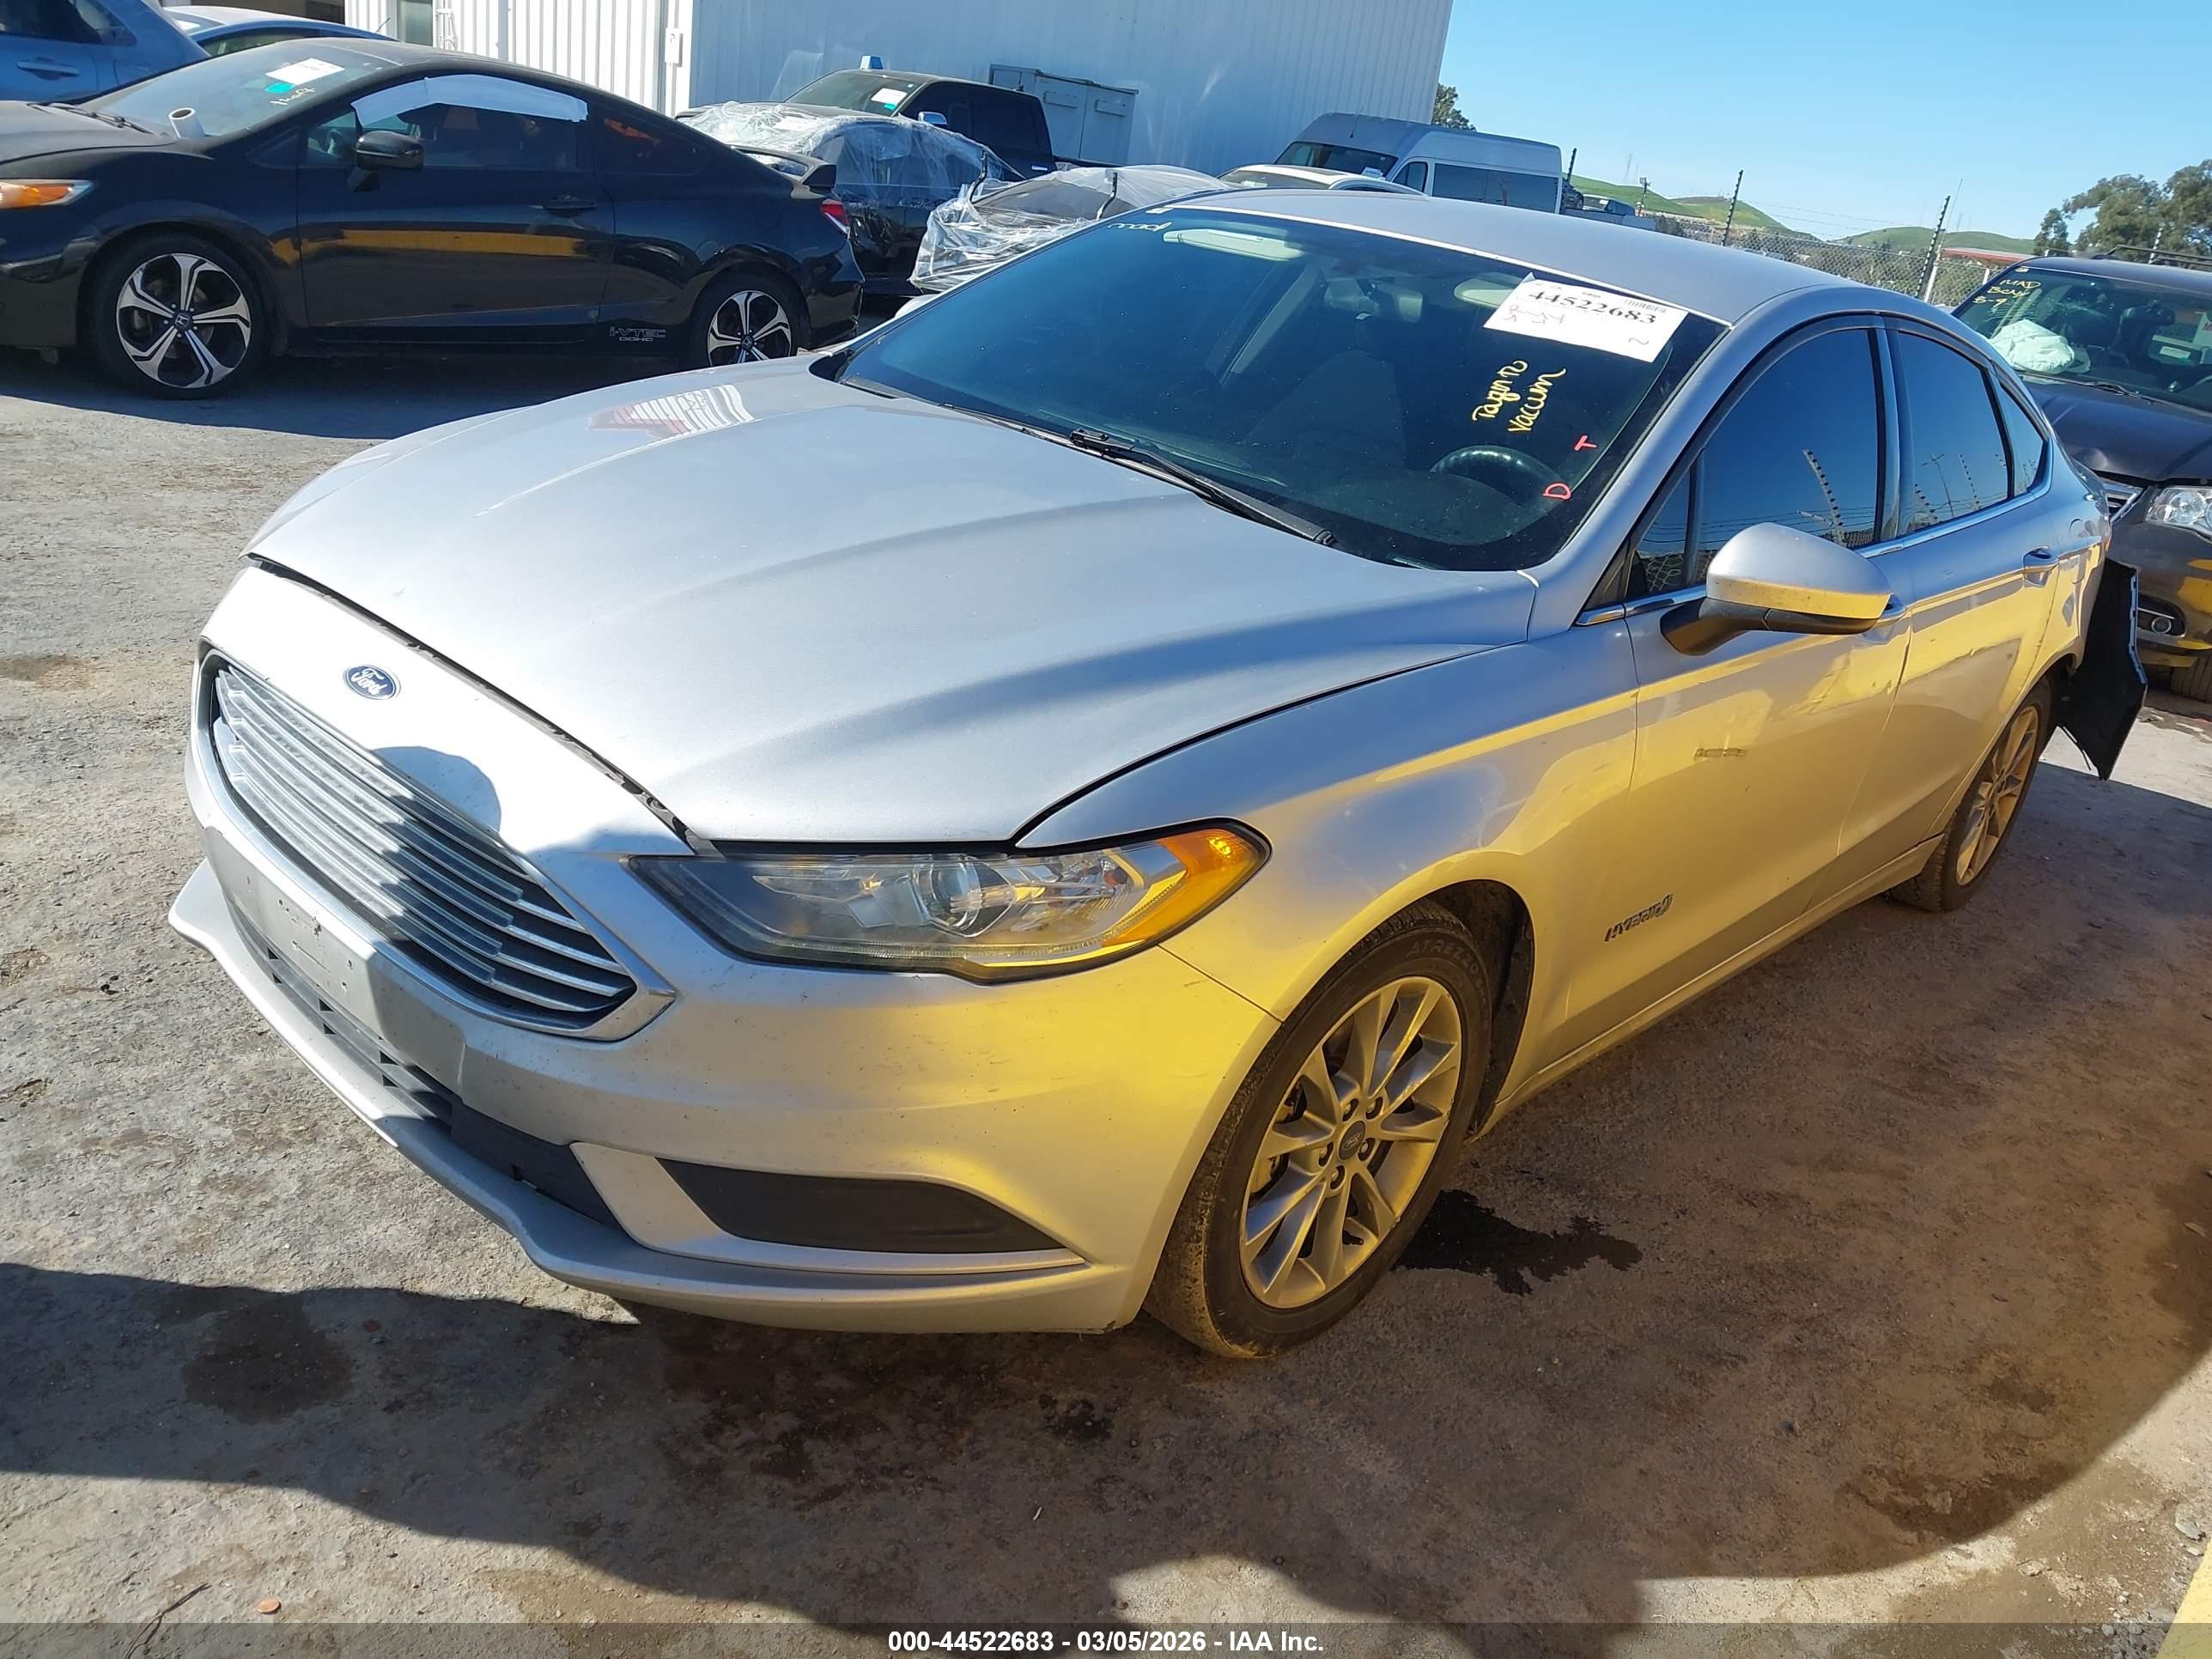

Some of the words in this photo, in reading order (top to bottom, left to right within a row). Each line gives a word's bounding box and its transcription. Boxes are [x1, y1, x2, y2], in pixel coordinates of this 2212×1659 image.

[1528, 290, 1657, 325] 44522683
[1542, 483, 1571, 500] D
[350, 668, 389, 696] Ford
